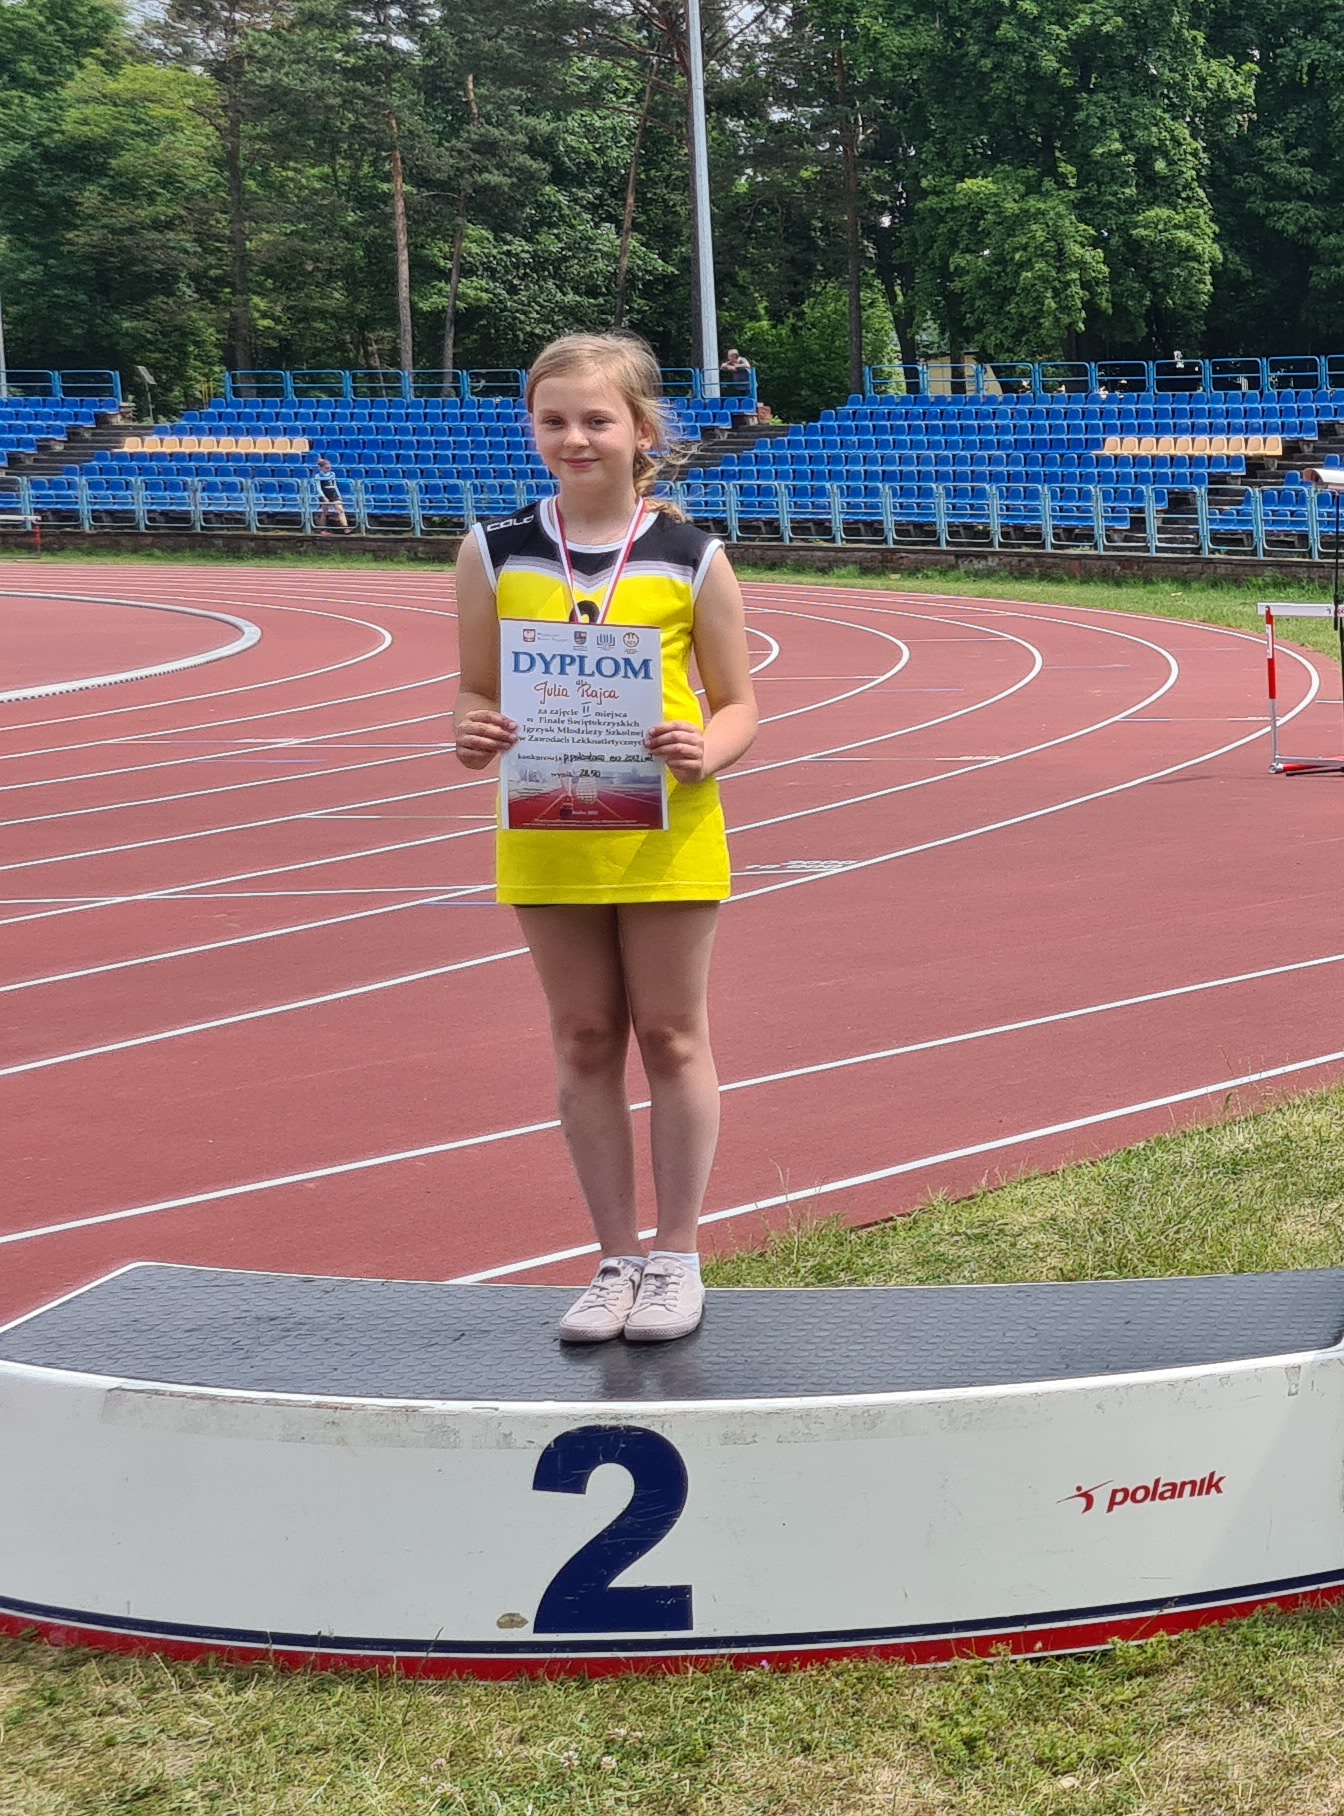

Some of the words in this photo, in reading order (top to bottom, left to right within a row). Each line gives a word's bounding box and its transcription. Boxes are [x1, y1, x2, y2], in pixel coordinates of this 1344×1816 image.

[512, 651, 653, 680] DYPLOM
[534, 681, 570, 704] Julia
[577, 683, 620, 705] Rajca
[1106, 1470, 1226, 1513] polanik
[532, 1424, 693, 1634] 2
